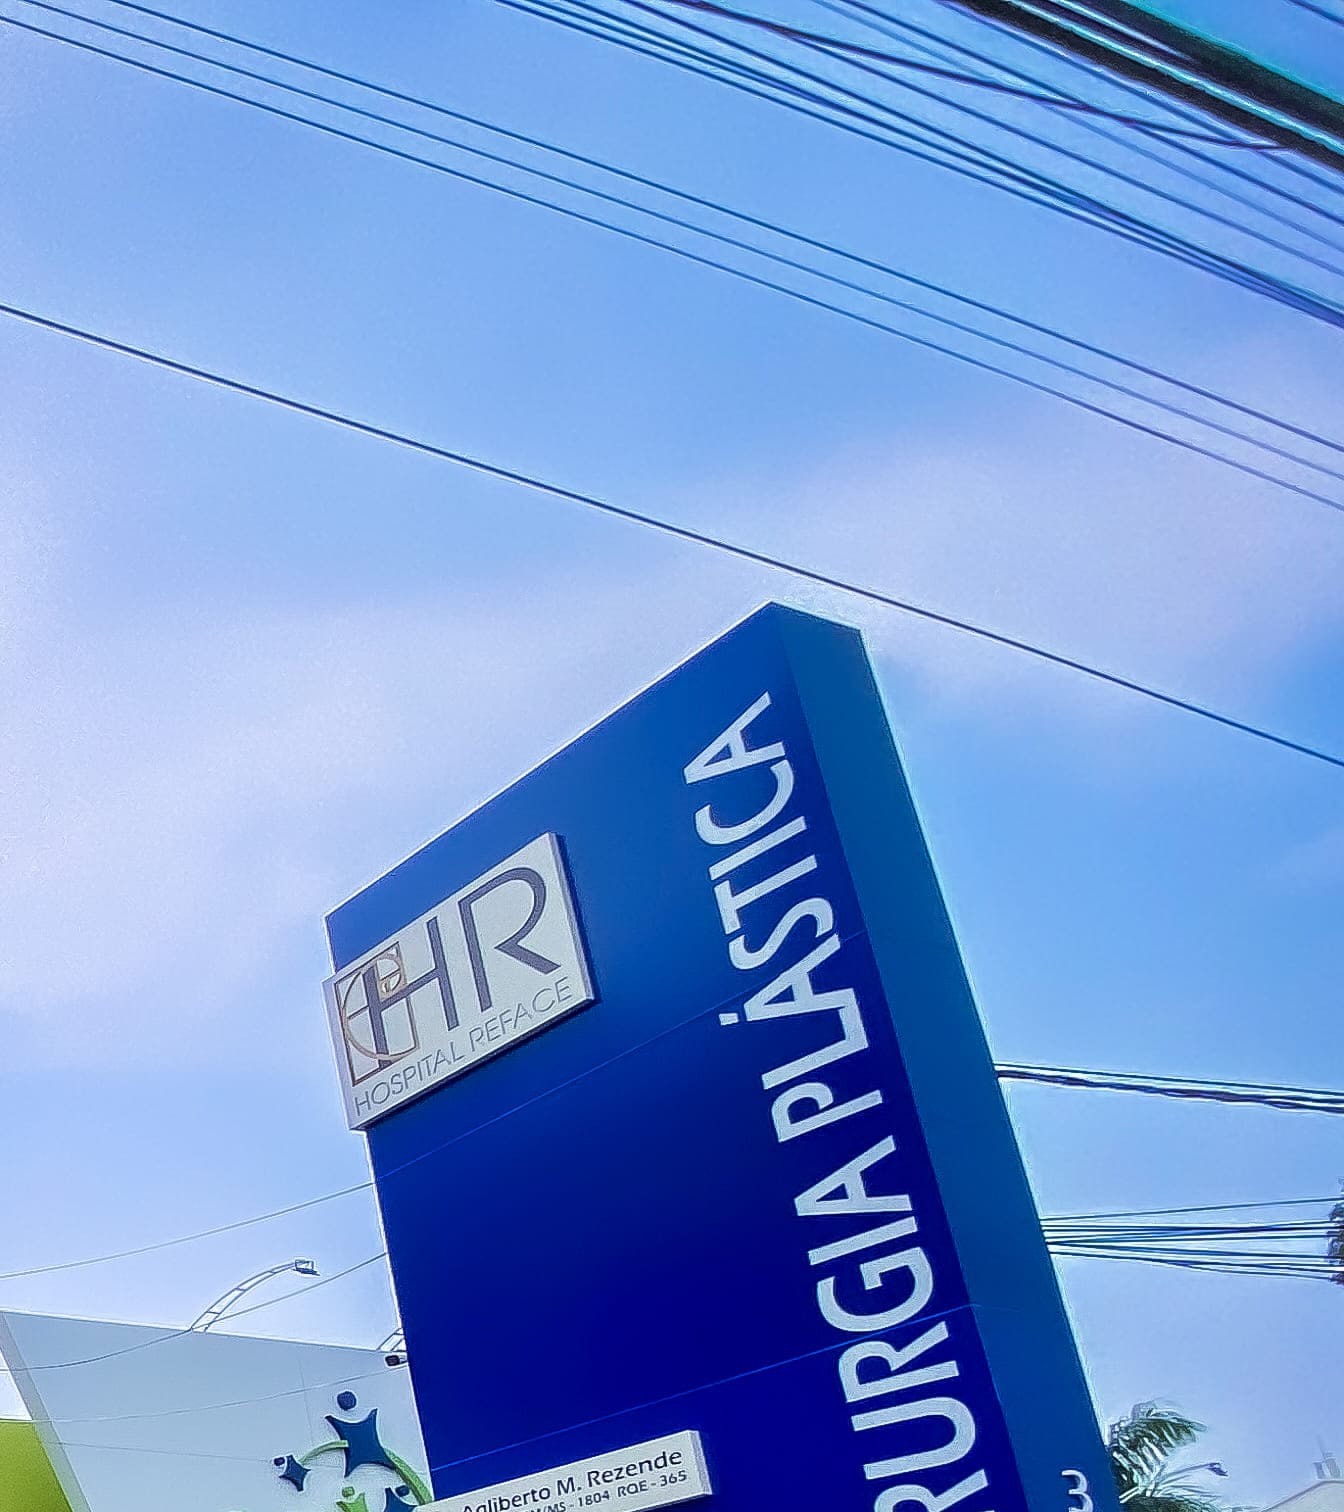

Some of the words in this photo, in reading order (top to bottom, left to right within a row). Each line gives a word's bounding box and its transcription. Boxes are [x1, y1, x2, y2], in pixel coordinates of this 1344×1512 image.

[682, 690, 885, 1143] PLÁSTICA
[354, 1041, 466, 1117] HOSPITAL
[469, 975, 574, 1052] REFACE
[556, 1476, 582, 1497] M.
[587, 1450, 683, 1488] Rezende
[578, 1490, 610, 1508] 1804
[660, 1470, 688, 1488] 365
